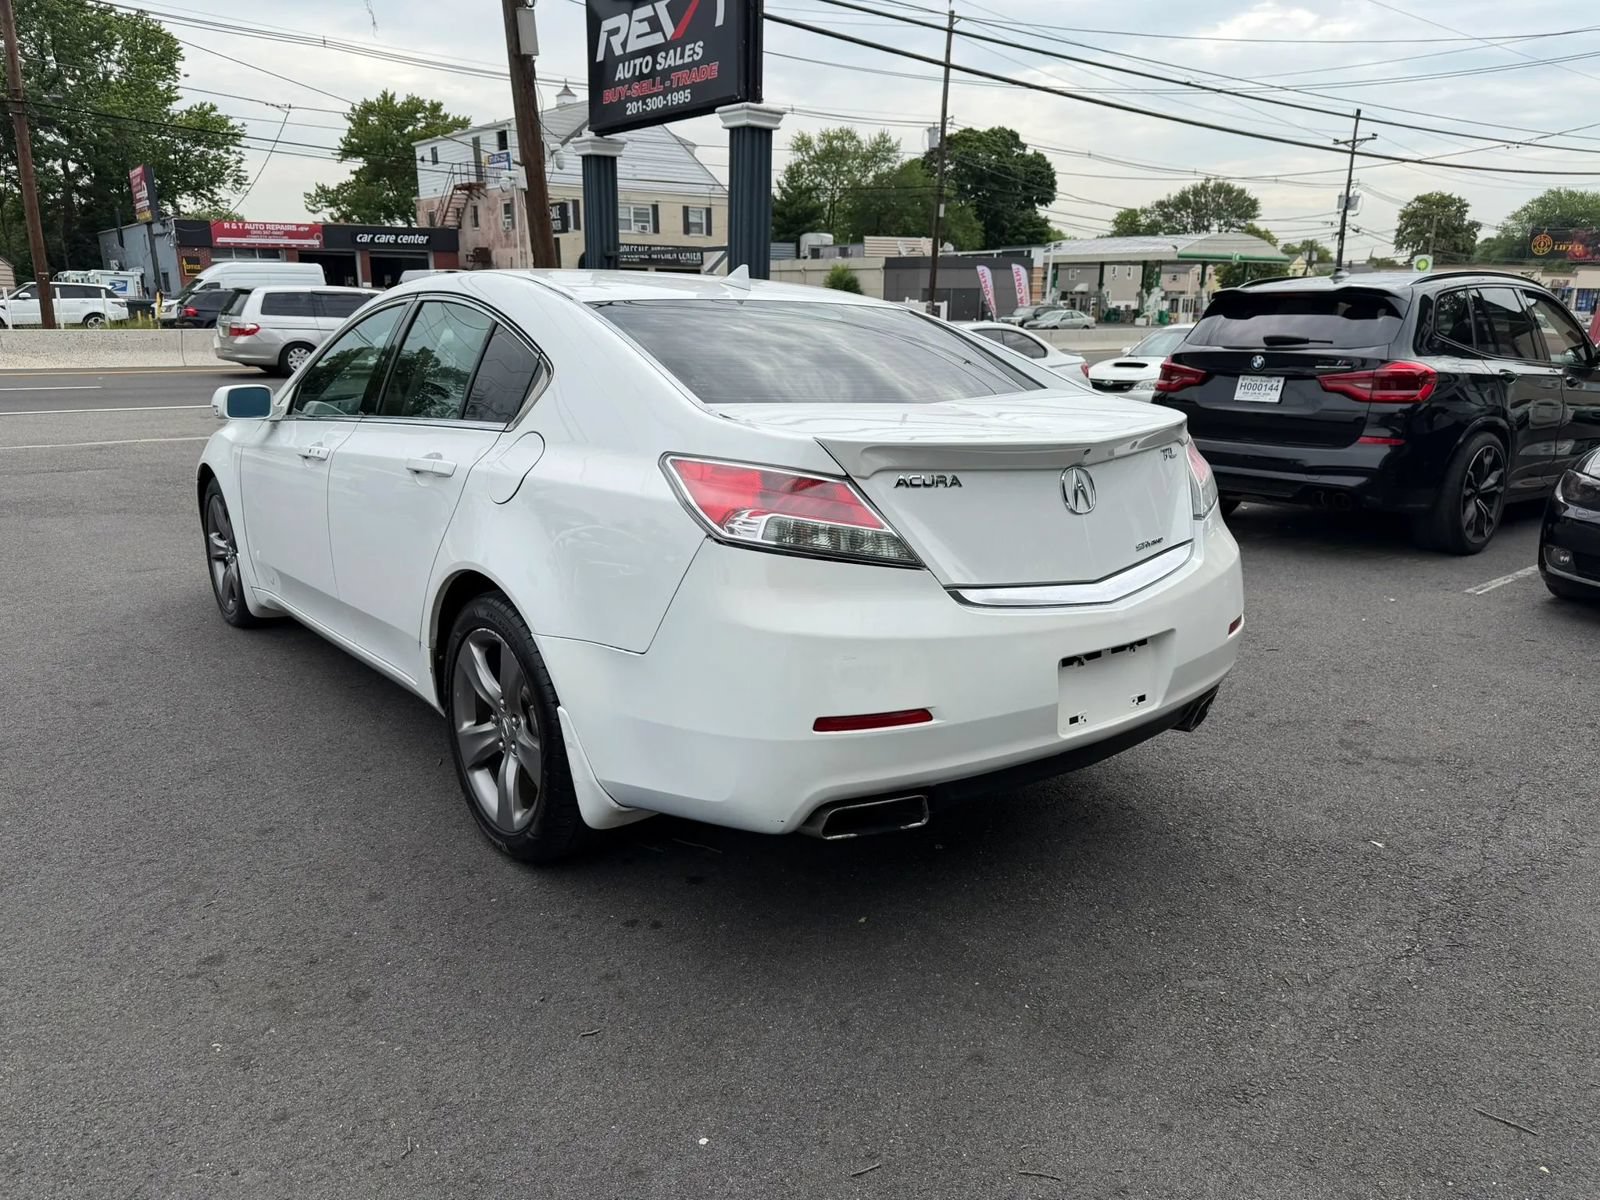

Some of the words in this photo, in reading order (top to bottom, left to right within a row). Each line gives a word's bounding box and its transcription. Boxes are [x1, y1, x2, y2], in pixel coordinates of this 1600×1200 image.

[615, 55, 653, 81] AUTO
[655, 40, 704, 71] SALES
[626, 89, 691, 115] 201-300-1995
[356, 233, 373, 243] car
[374, 233, 396, 243] care
[397, 233, 429, 244] center
[1239, 382, 1280, 392] H000144
[1160, 447, 1177, 461] TL
[893, 474, 963, 489] ACURA
